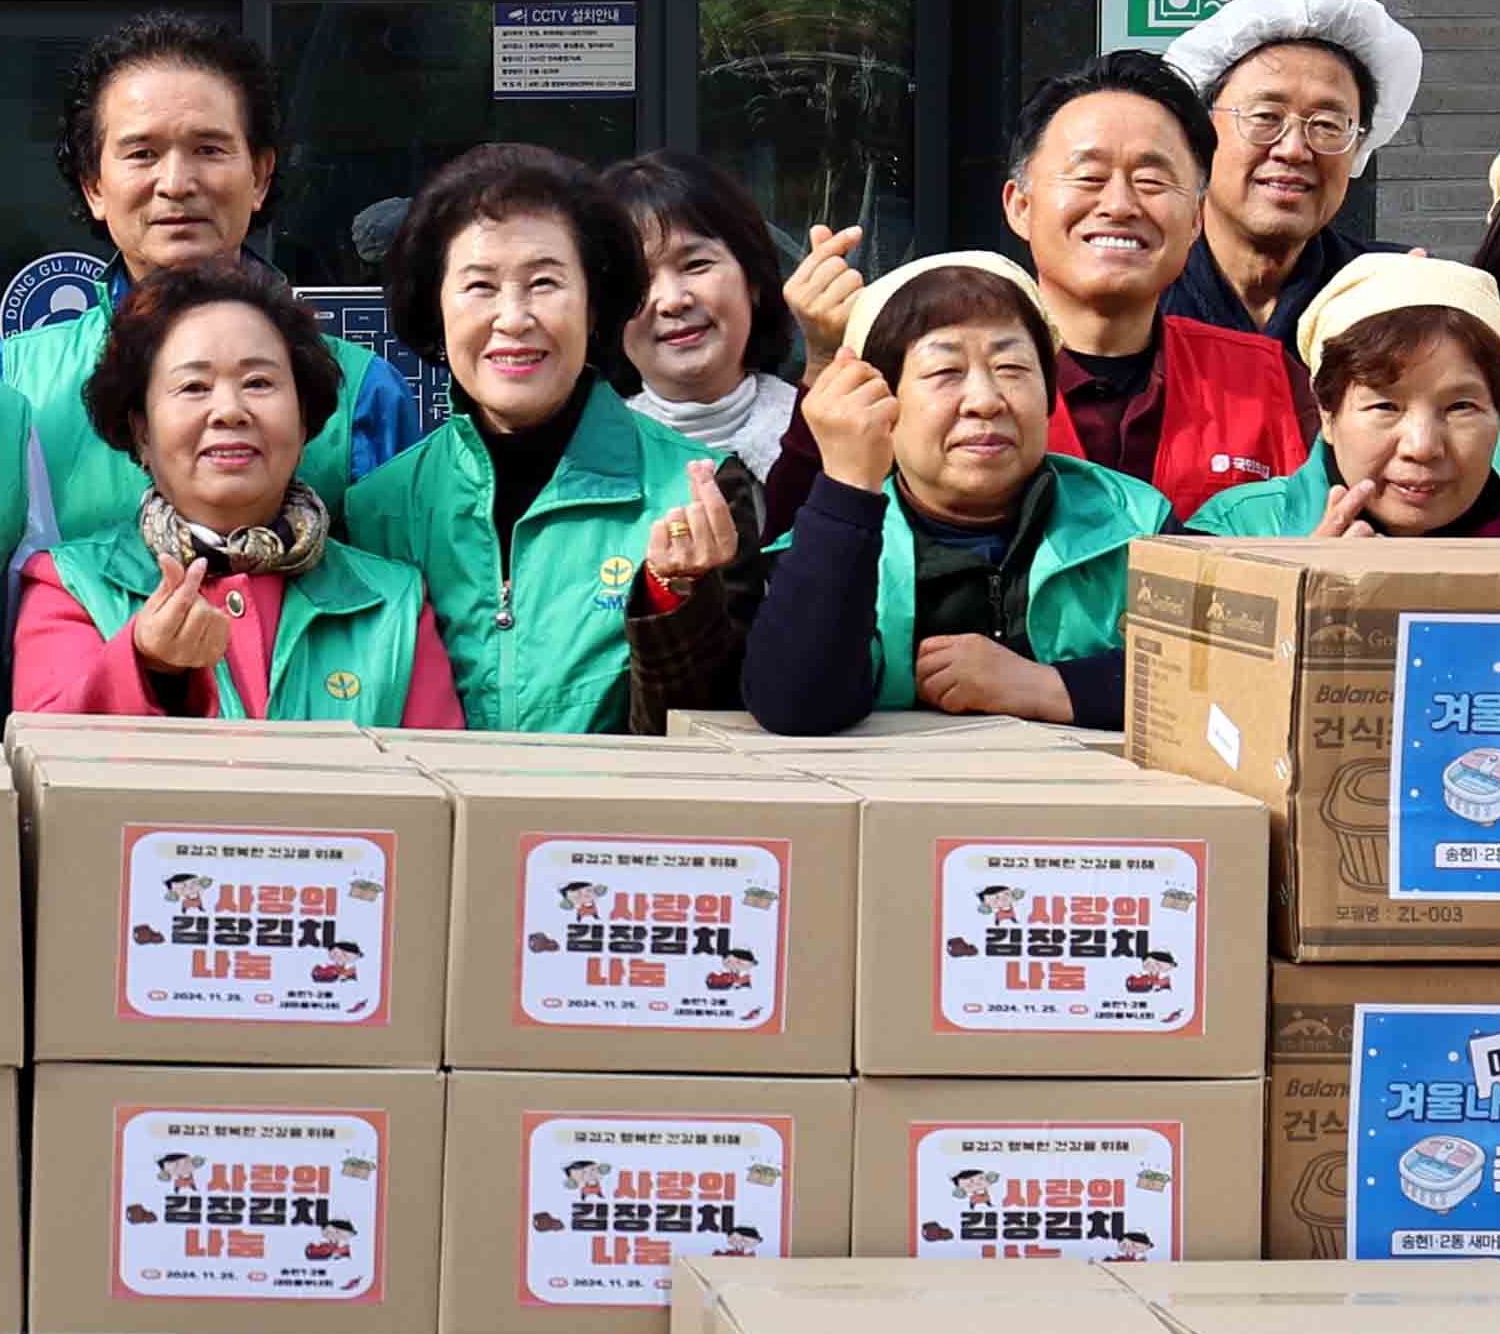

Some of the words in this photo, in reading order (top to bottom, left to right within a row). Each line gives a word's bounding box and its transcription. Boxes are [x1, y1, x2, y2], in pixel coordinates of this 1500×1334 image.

[532, 9, 567, 23] CCTV
[5, 274, 36, 320] DONG
[609, 892, 732, 923] 사랑의
[1398, 904, 1463, 923] ZL-003
[566, 923, 731, 956] 김장김치
[586, 956, 667, 987] 나눔
